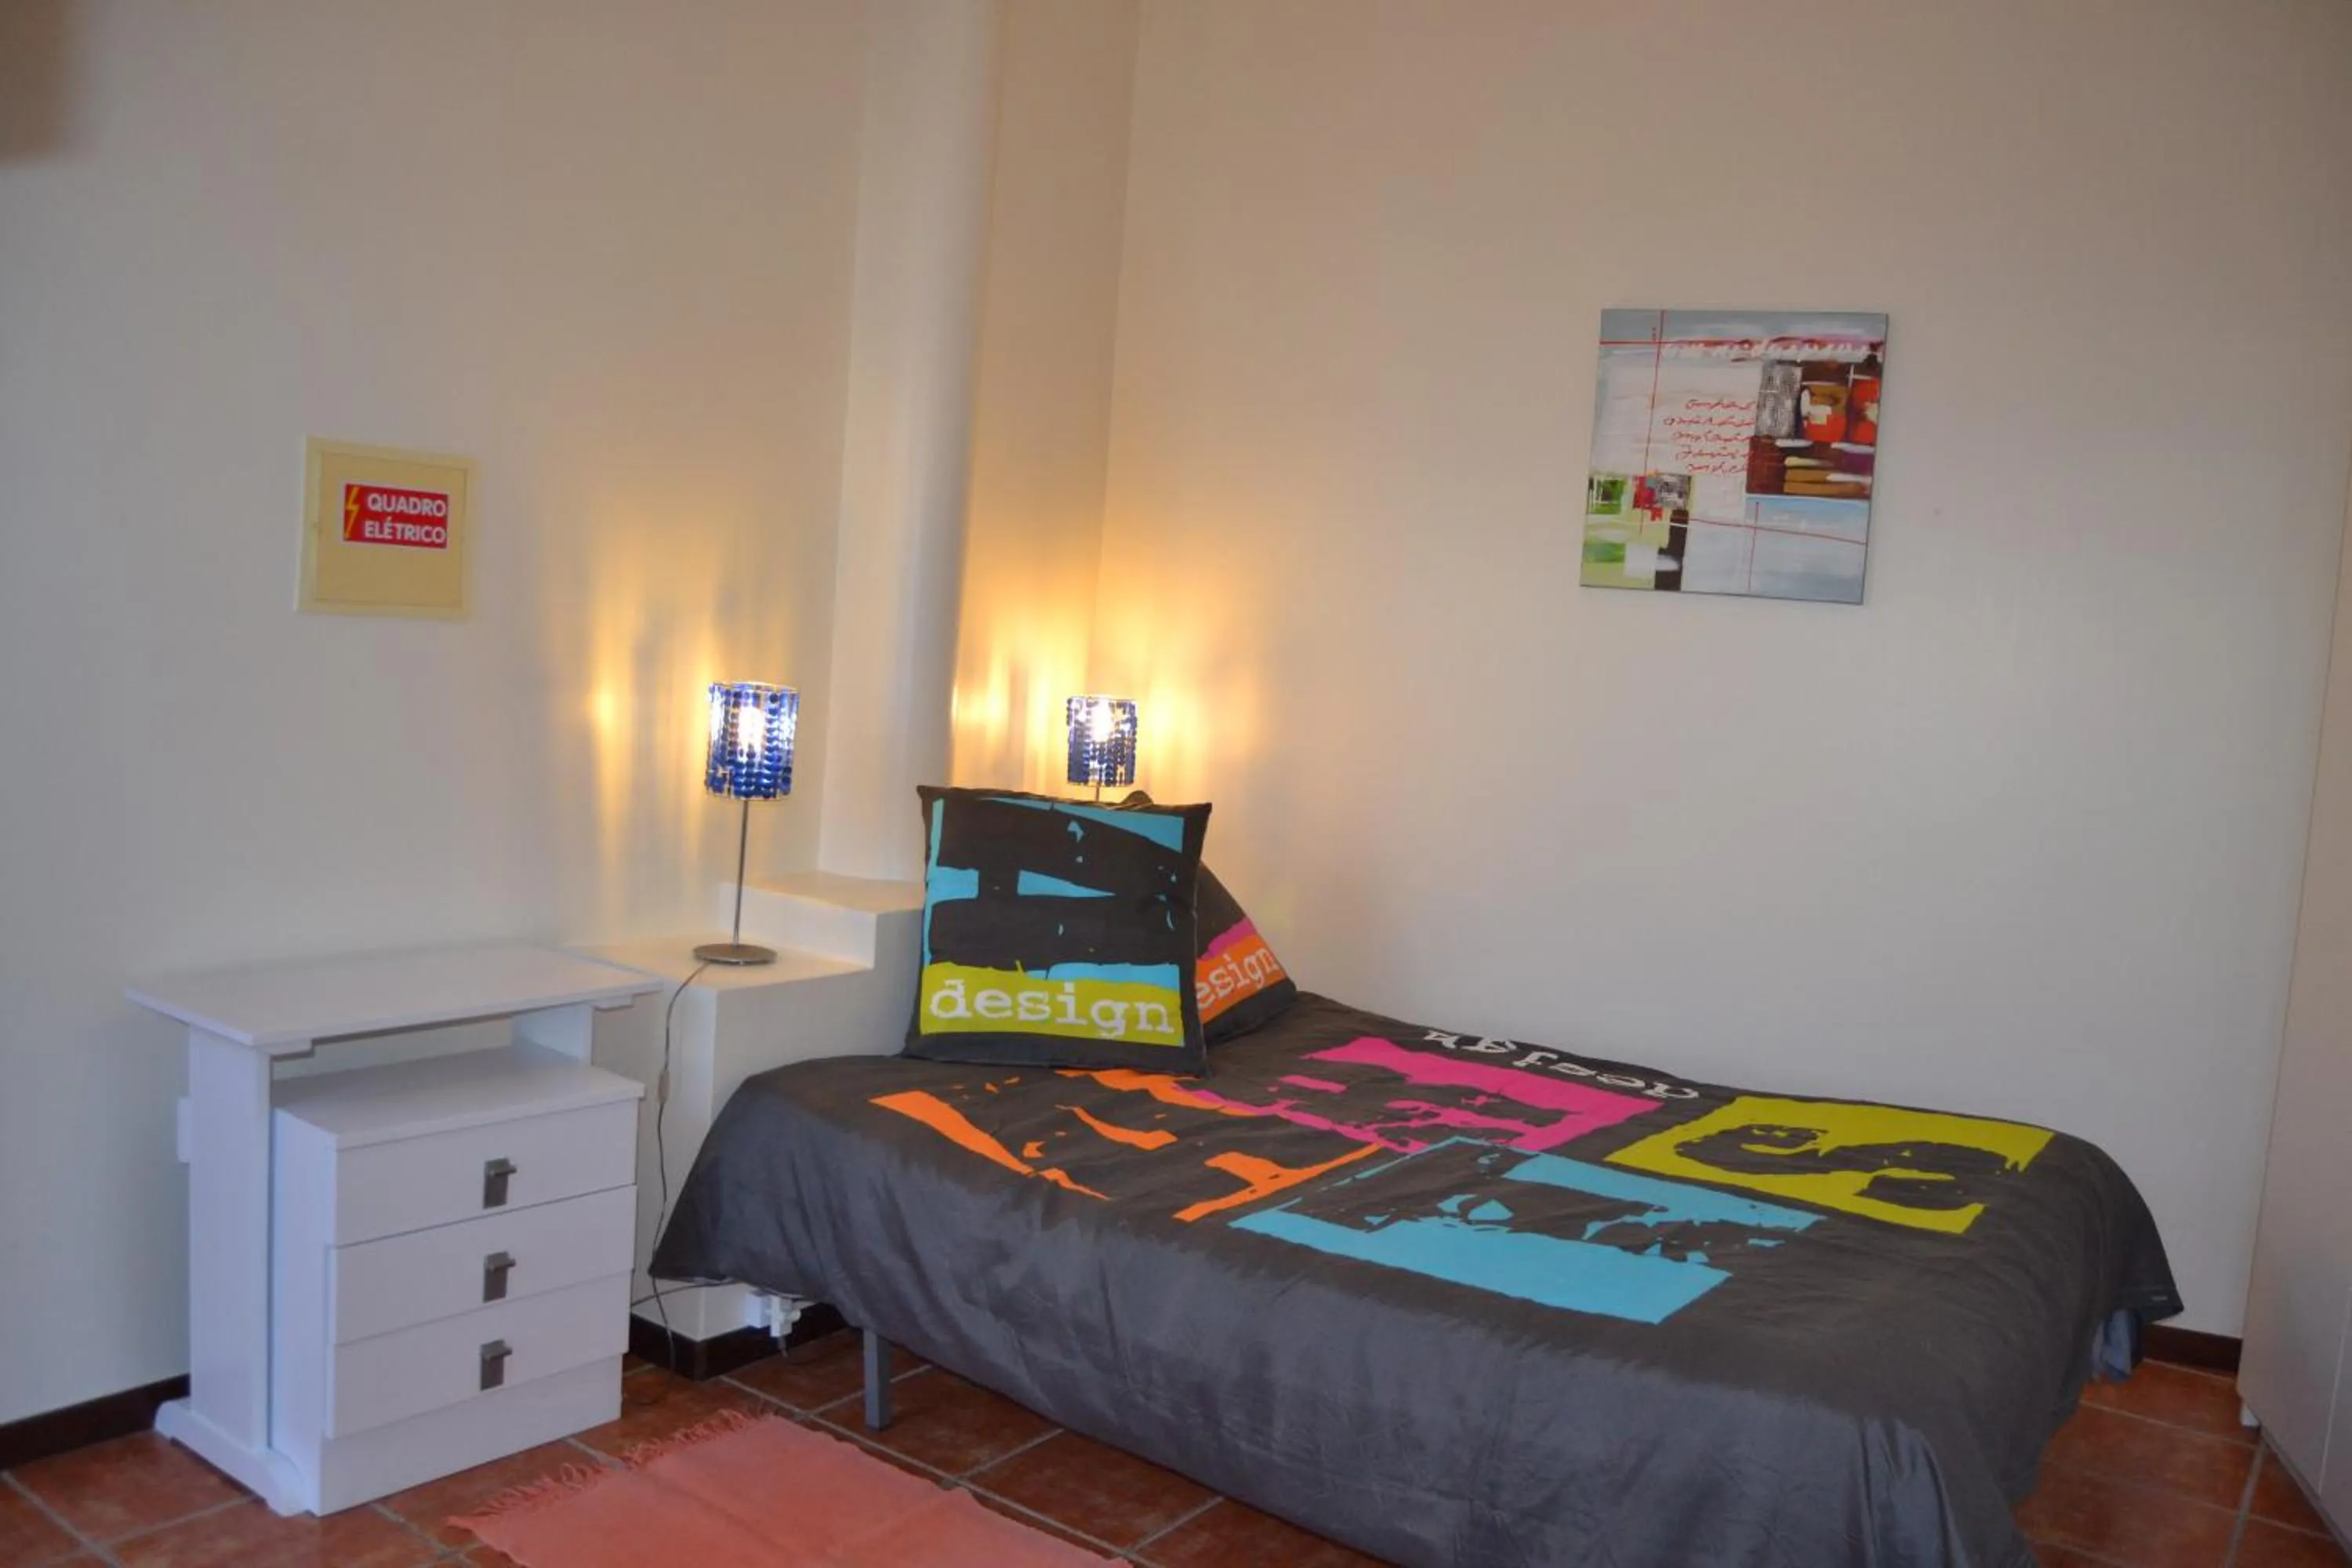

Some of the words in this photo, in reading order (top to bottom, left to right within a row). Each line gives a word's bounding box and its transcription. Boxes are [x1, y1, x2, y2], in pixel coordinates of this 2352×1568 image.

[367, 493, 446, 517] QUADRO
[364, 517, 446, 543] ELÉTRICO
[1195, 947, 1281, 1010] esign
[928, 978, 1175, 1037] design
